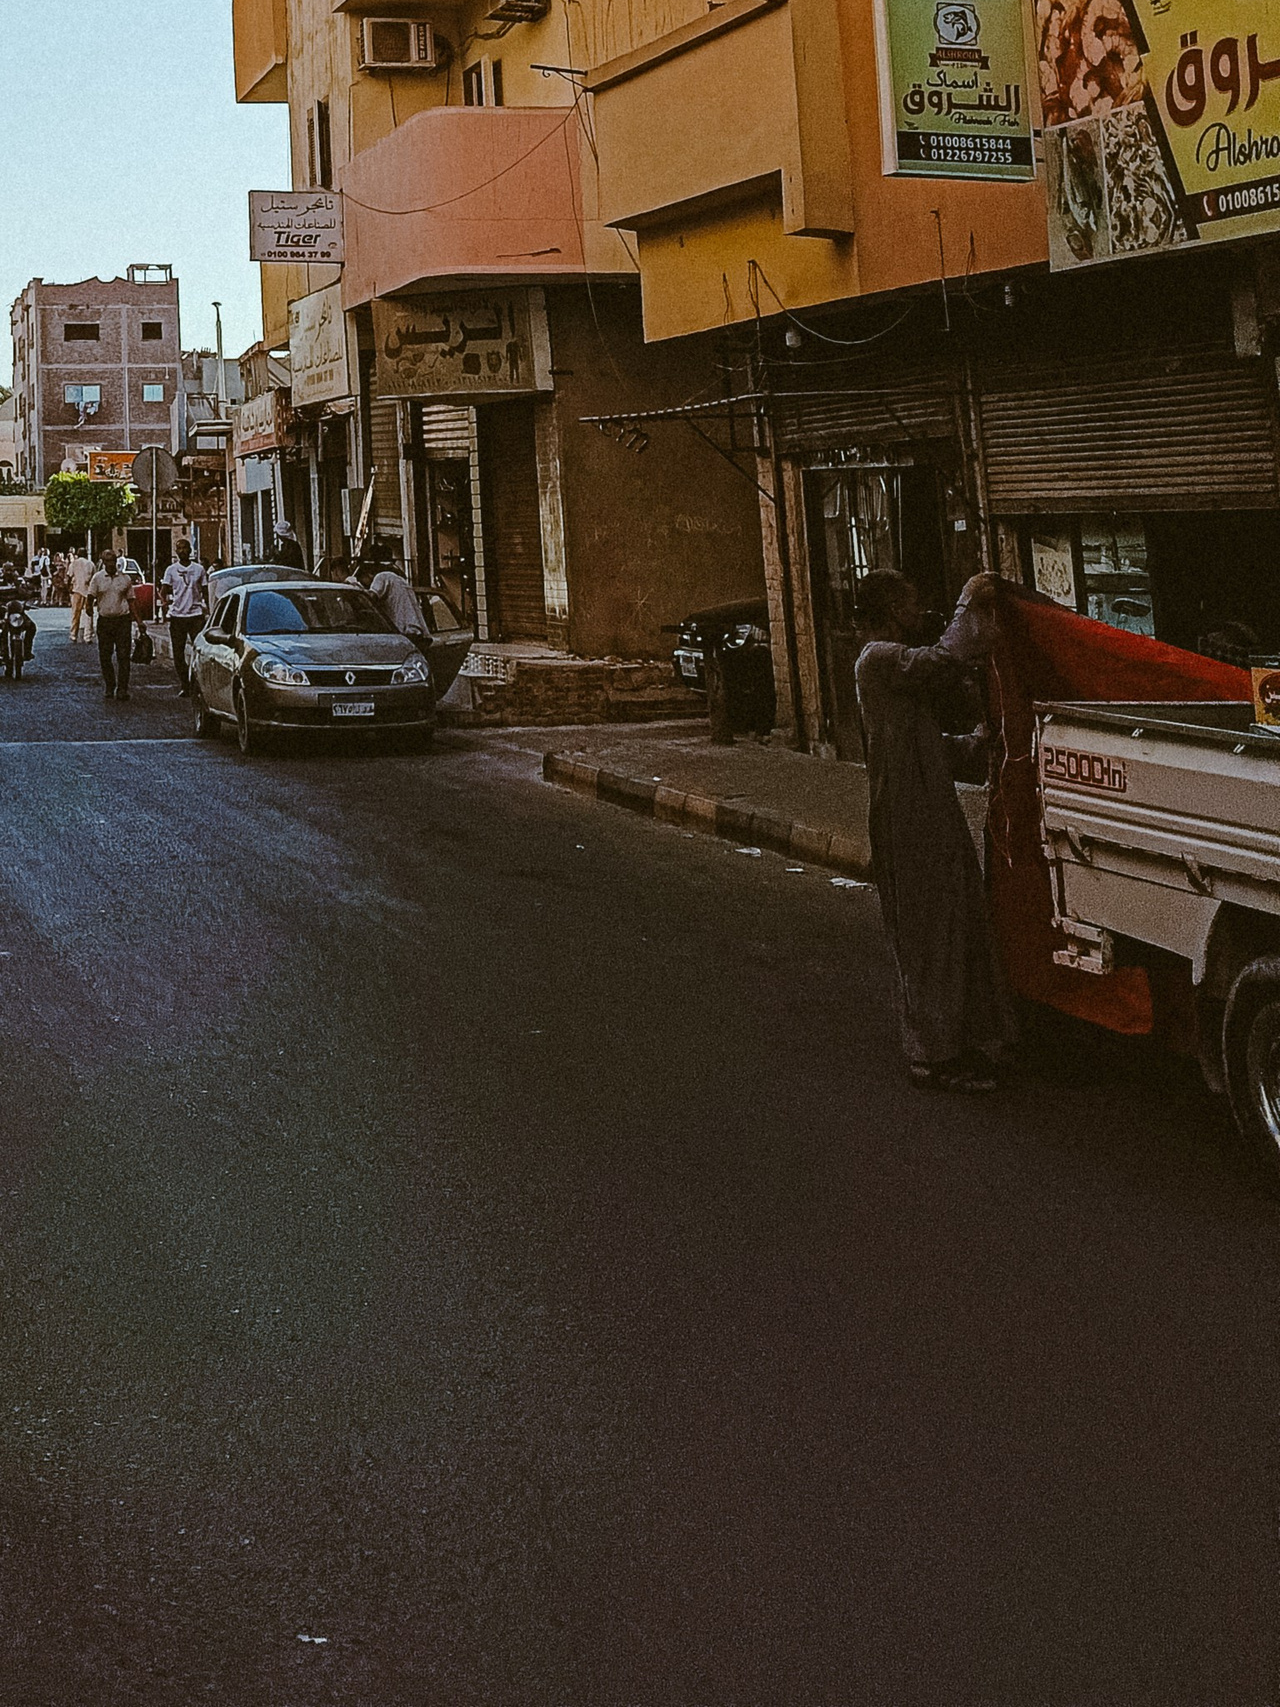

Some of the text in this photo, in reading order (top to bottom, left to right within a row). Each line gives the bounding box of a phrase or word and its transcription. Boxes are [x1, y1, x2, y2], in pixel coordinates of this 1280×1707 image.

[902, 81, 1021, 115] الشروق
[930, 135, 1012, 150] 01008615844
[931, 149, 1013, 163] 01226797255
[274, 231, 321, 246] Tiger
